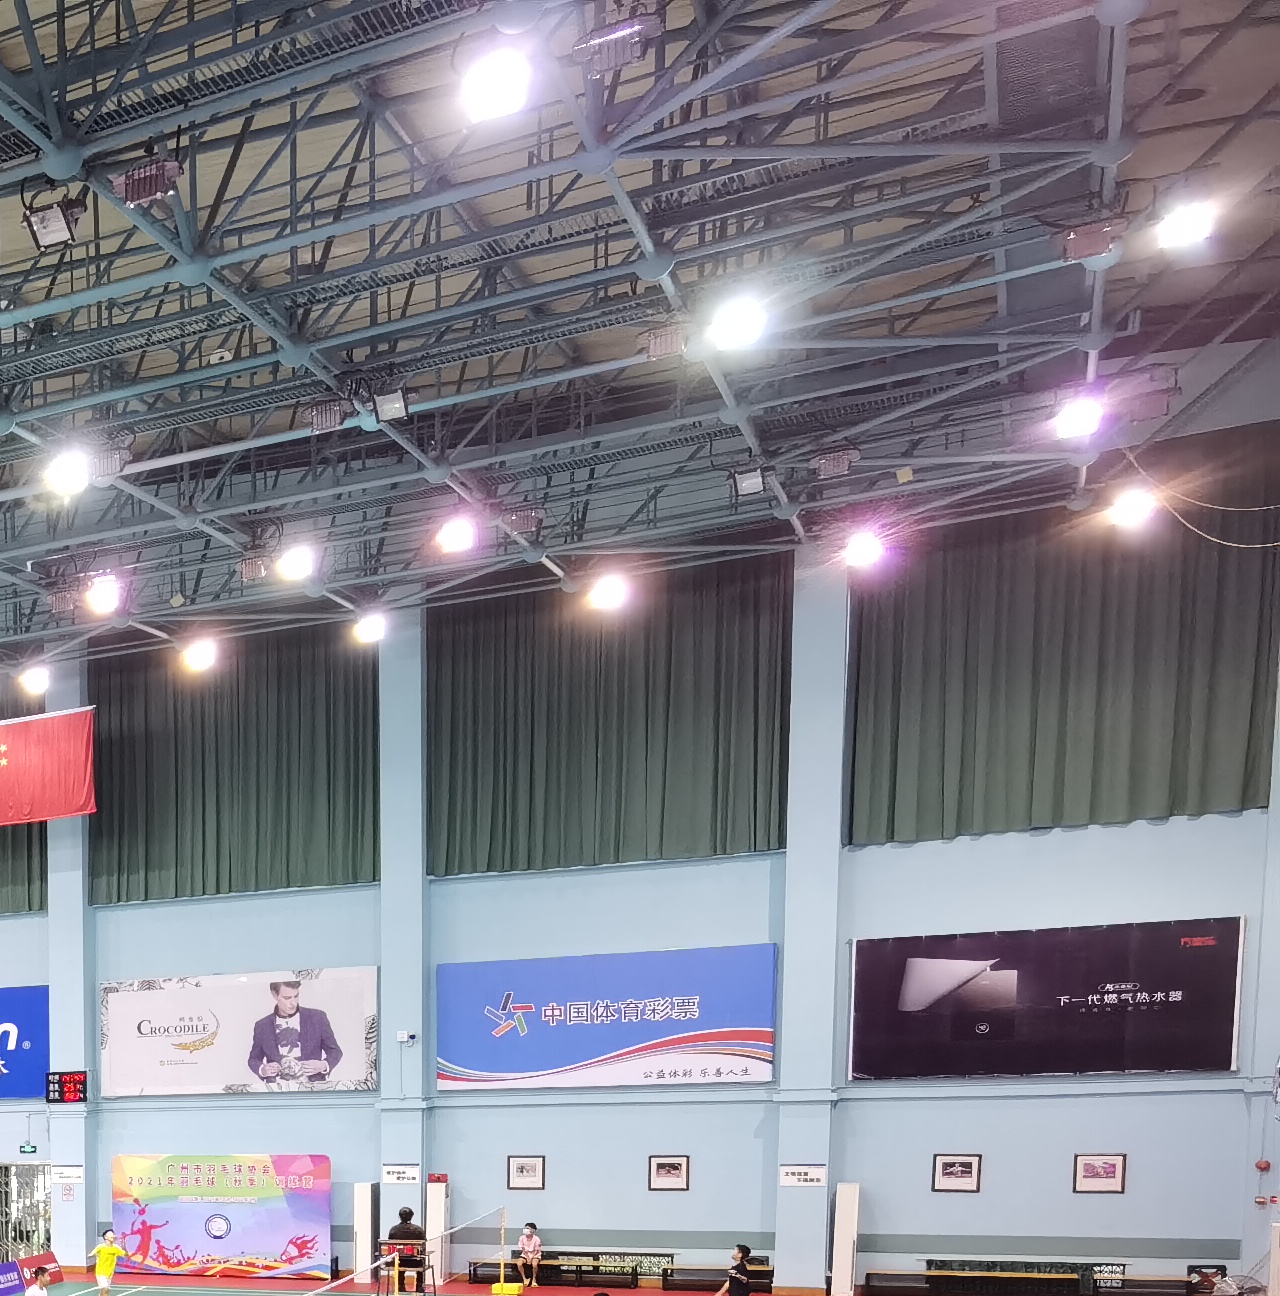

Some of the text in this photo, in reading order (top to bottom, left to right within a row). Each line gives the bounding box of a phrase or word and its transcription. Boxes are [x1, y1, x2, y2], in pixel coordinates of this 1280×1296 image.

[1056, 991, 1183, 1006] 下一代燃气热水器
[541, 996, 700, 1025] 中国体育彩票
[137, 1019, 209, 1036] CROCODILE
[167, 1163, 271, 1175] 广州市羽毛球协会
